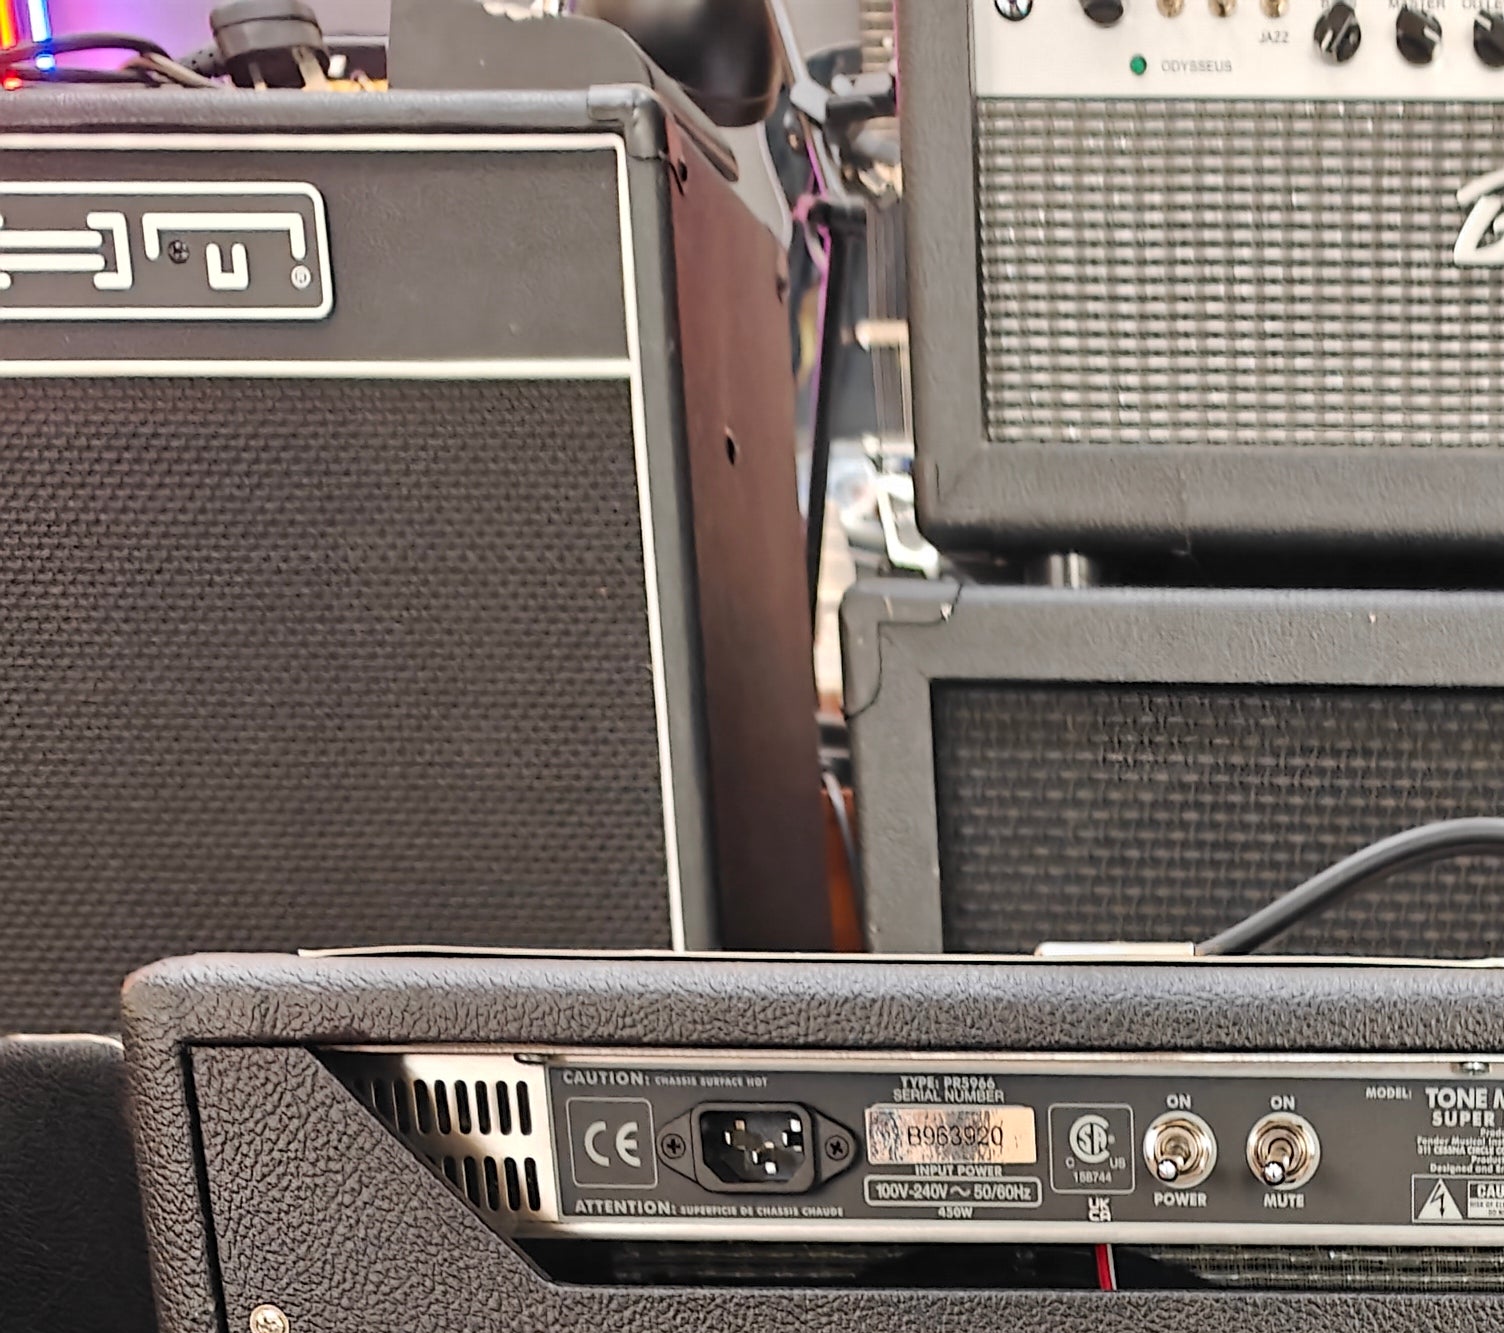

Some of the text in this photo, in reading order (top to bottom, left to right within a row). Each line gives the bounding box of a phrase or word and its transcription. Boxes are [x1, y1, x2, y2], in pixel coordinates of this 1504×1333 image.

[1259, 31, 1289, 43] JAZZ
[1161, 60, 1232, 72] ODYSSEUS
[563, 1071, 768, 1087] CAUTION: CHASSIS SURFACE HOT
[943, 1076, 996, 1089] PR5966
[894, 1089, 1004, 1102] SERIAL NUMBER
[1166, 1094, 1191, 1109] ON
[1270, 1095, 1295, 1110] ON
[1425, 1087, 1487, 1110] TONE
[1431, 1110, 1495, 1127] SUPER
[907, 1125, 1004, 1146] B963920
[584, 1120, 641, 1167] CE
[915, 1165, 1002, 1176] INPUT POWER
[875, 1183, 1031, 1199] 100V-240V 50/60Hz
[1154, 1192, 1207, 1207] POWER
[1264, 1193, 1304, 1208] MUTE
[575, 1200, 843, 1217] ATTENTION: SUPERFICIE DE CHASSIS CHAUDE
